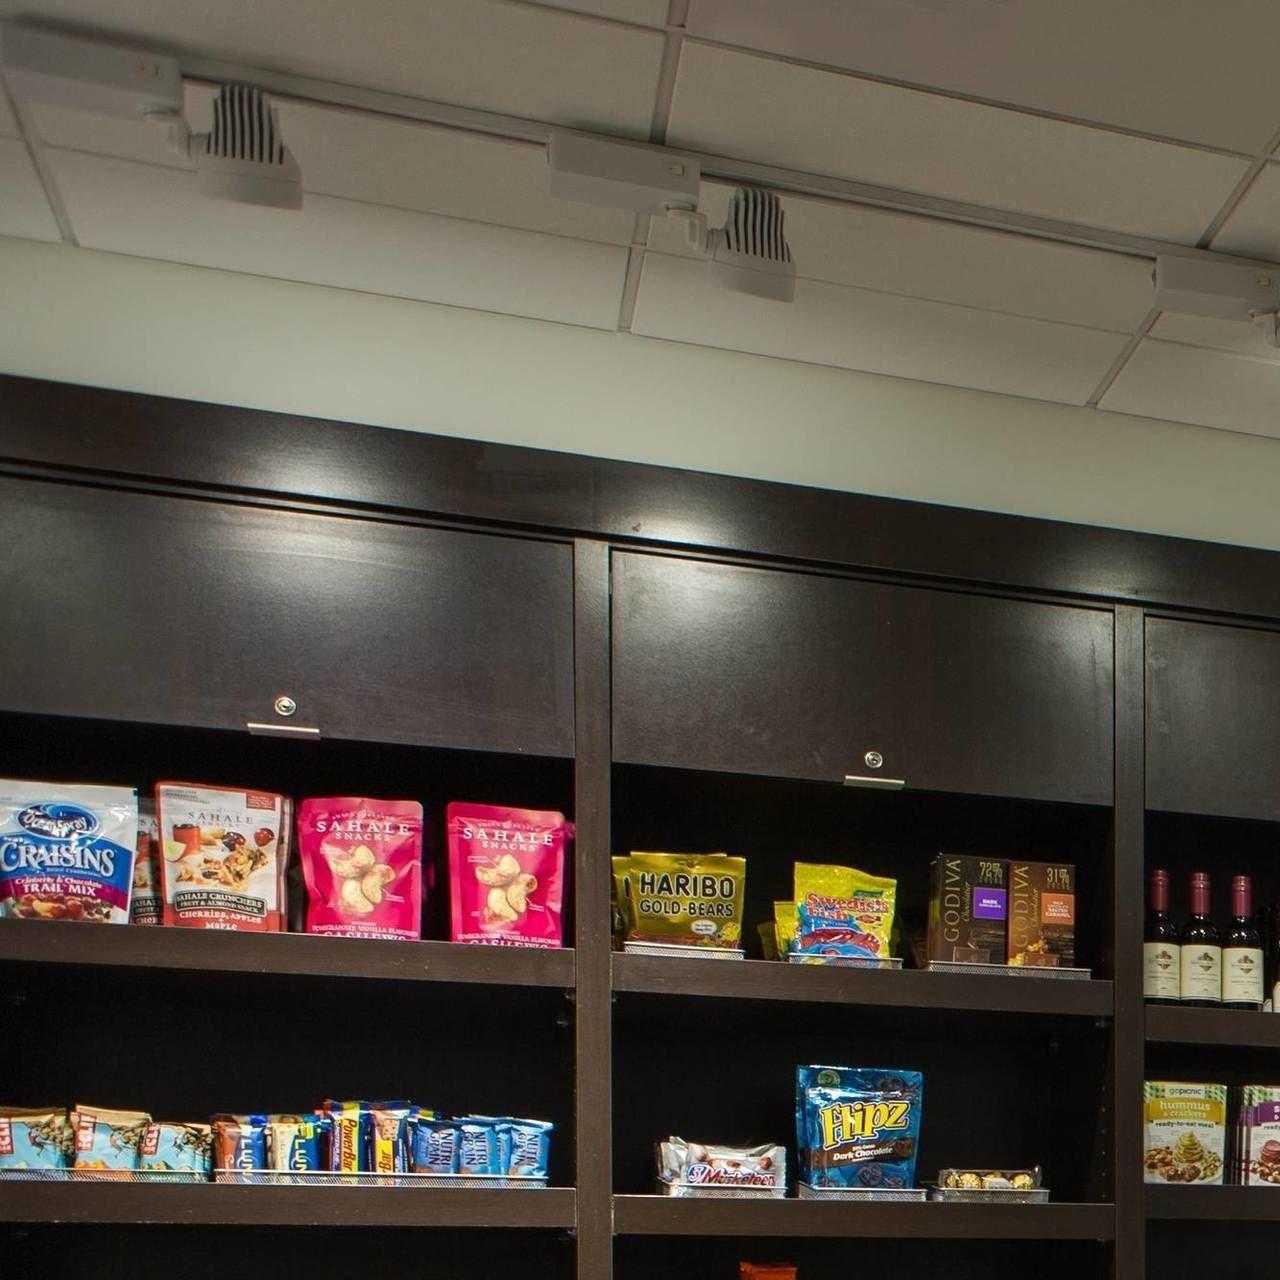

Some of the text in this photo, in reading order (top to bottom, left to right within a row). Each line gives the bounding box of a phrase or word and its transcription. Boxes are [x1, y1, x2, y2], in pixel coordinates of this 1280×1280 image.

[187, 810, 254, 824] SAHALE
[316, 821, 412, 836] SAHALE
[335, 832, 393, 842] SNACKS
[463, 827, 554, 847] SAHALE
[481, 841, 536, 852] SNACKS
[978, 861, 1003, 879] 72%
[23, 882, 96, 896] TRAIL MIX
[639, 870, 736, 900] HARIBO
[639, 898, 735, 918] GOLD-BEARS
[944, 859, 961, 942] GODIVA
[1013, 865, 1031, 948] GODIVA
[1160, 1100, 1211, 1111] hummus
[820, 1101, 911, 1151] Flipz
[1155, 1120, 1197, 1128] ready-to-eat
[343, 1118, 357, 1172] PowerBar
[429, 1132, 442, 1167] GRAIN
[440, 1132, 454, 1168] NUTRI
[464, 1131, 487, 1167] NUTRI GRAIN
[527, 1133, 539, 1167] NUTRI
[833, 1151, 854, 1161] Dark
[855, 1147, 893, 1158] Chocolate
